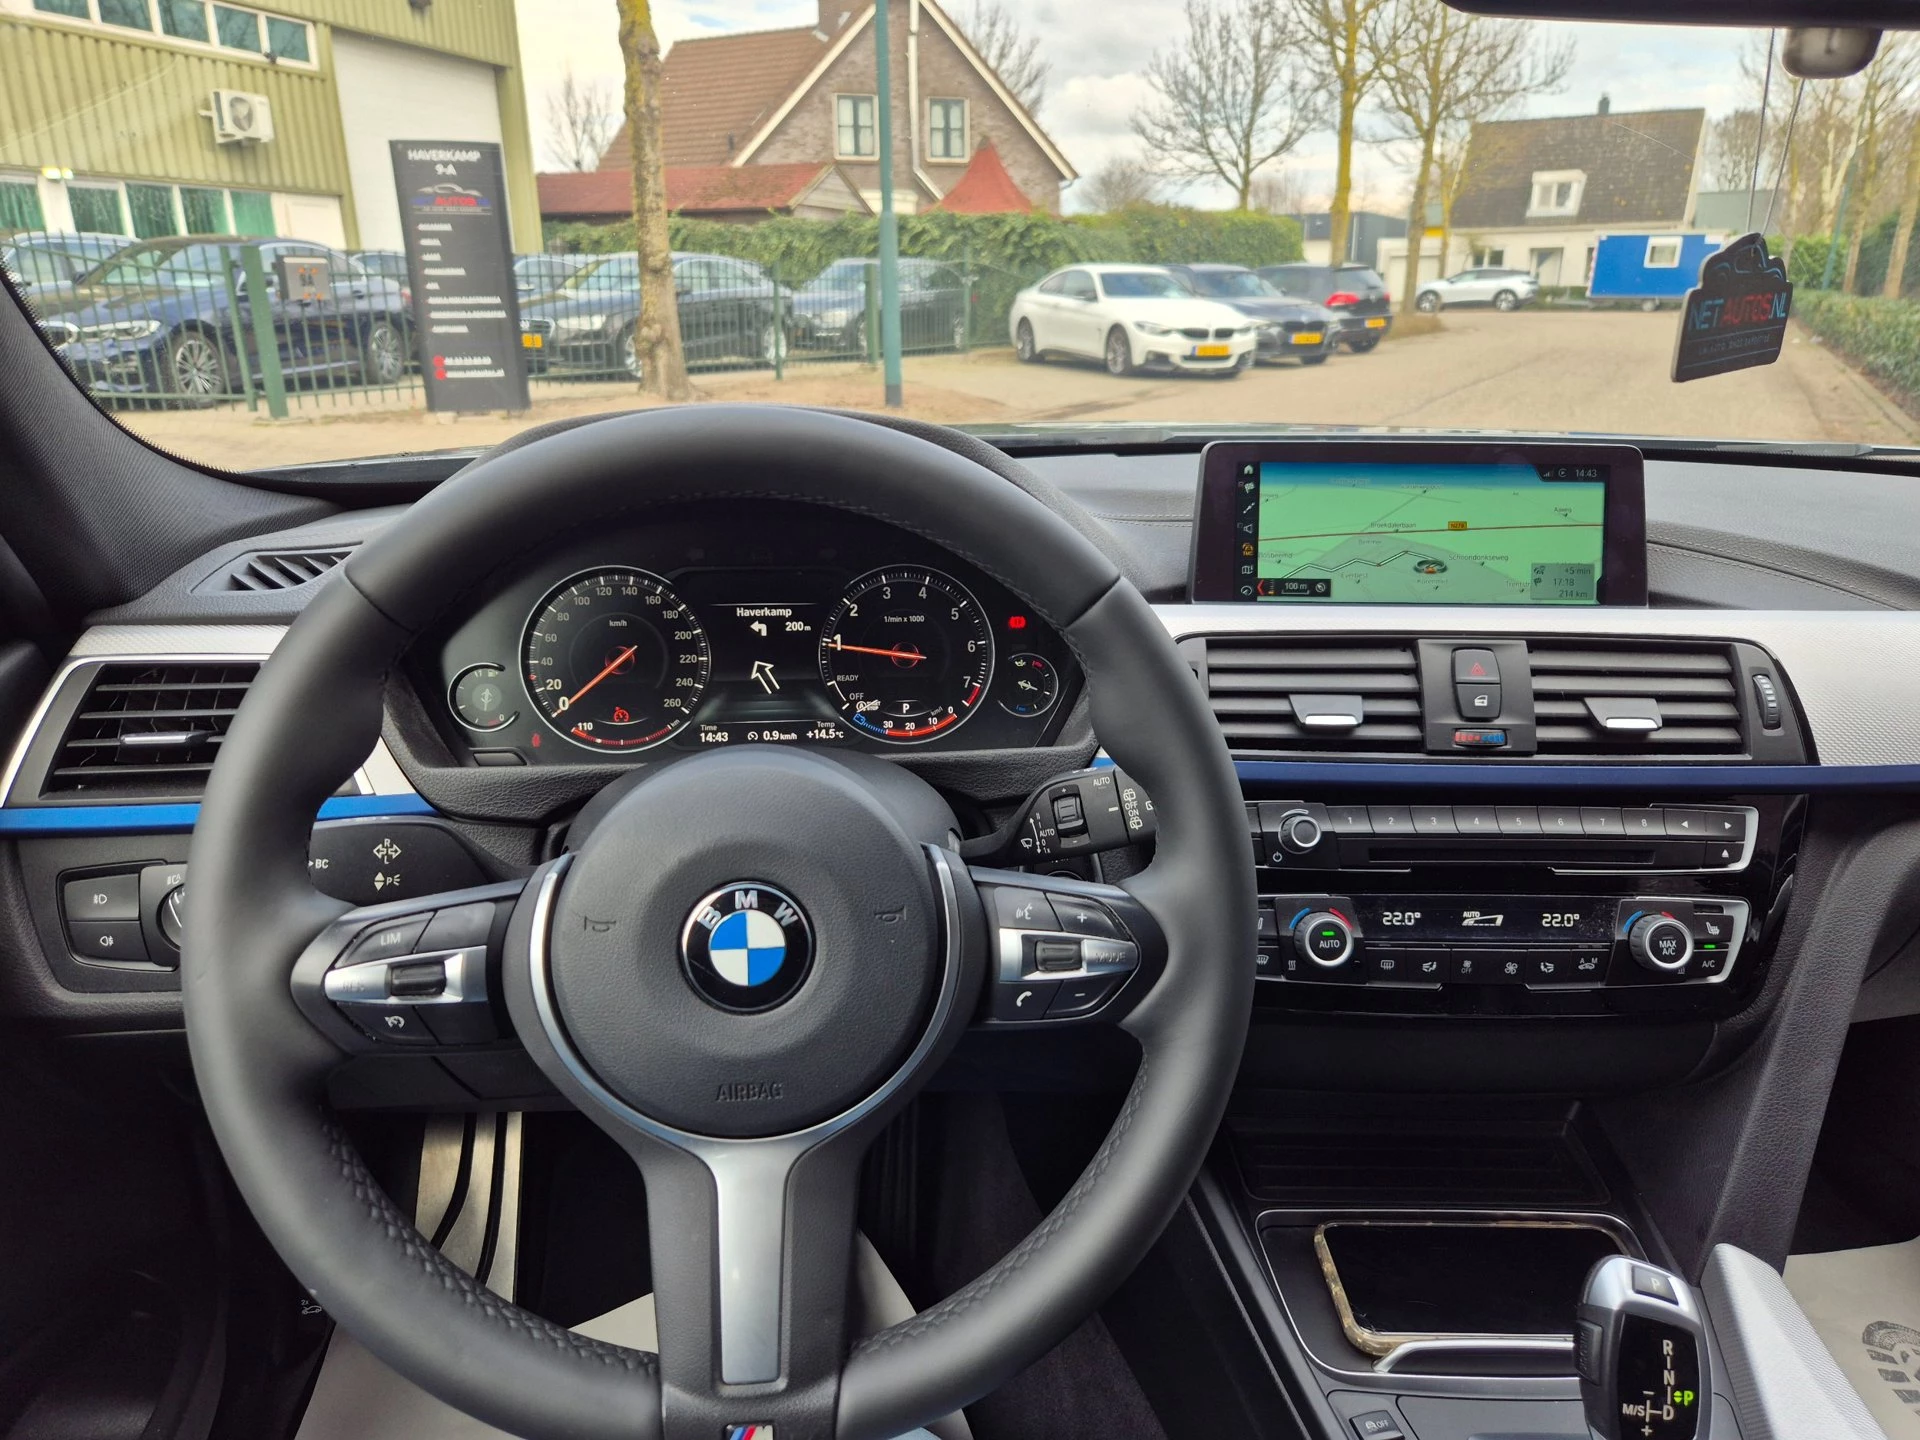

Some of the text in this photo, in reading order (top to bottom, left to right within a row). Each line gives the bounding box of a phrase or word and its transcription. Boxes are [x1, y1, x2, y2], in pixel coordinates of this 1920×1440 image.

[407, 149, 481, 162] HAVERKAMP
[1575, 469, 1598, 478] 14:43
[1285, 582, 1298, 590] 100
[596, 587, 612, 595] 120
[621, 587, 638, 595] 140
[883, 586, 891, 599] 3
[918, 586, 927, 599] 4
[574, 597, 590, 605] 100
[645, 596, 661, 605] 160
[662, 610, 679, 619] 180
[736, 607, 792, 618] Haverkamp
[849, 604, 858, 617] 2
[951, 607, 959, 620] 5
[557, 612, 569, 621] 80
[884, 615, 902, 623] 1/min
[909, 615, 925, 623] 1000
[545, 633, 557, 642] 60
[674, 631, 692, 640] 200
[833, 634, 842, 651] 1
[967, 640, 976, 653] 6
[541, 657, 553, 666] 40
[679, 655, 697, 663] 220
[675, 678, 693, 686] 240
[836, 674, 859, 682] READY
[963, 676, 971, 688] 7
[546, 679, 562, 690] 20
[559, 696, 569, 710] 0
[664, 699, 681, 707] 260
[903, 703, 910, 714] P
[928, 717, 938, 725] 10
[578, 722, 593, 730] 110
[905, 722, 915, 730] 20
[700, 732, 728, 742] 14:43
[1093, 776, 1110, 786] AUTO
[1124, 801, 1138, 810] OFF
[1128, 809, 1139, 817] ON
[1348, 817, 1353, 825] 1
[1388, 817, 1393, 825] 2
[1431, 817, 1436, 826] 3
[1474, 817, 1479, 825] 4
[1516, 818, 1521, 826] 5
[1558, 818, 1564, 826] 6
[1600, 818, 1605, 826] 7
[1641, 818, 1647, 827] 8
[1039, 829, 1055, 837] AUTO
[315, 859, 329, 869] BC
[386, 877, 392, 885] P
[697, 890, 798, 930] BMW
[380, 933, 401, 946] LIM
[1319, 940, 1340, 949] AUTO
[1659, 940, 1677, 949] MAX
[1662, 947, 1676, 956] A/C
[1702, 960, 1716, 969] A/C
[716, 1083, 784, 1102] AIRBAG
[1651, 1278, 1660, 1290] P
[1662, 1339, 1673, 1356] R
[1664, 1370, 1675, 1386] N
[1683, 1391, 1694, 1406] P
[1622, 1403, 1645, 1416] M/S
[1662, 1405, 1674, 1421] D
[1376, 1420, 1389, 1428] OFF
